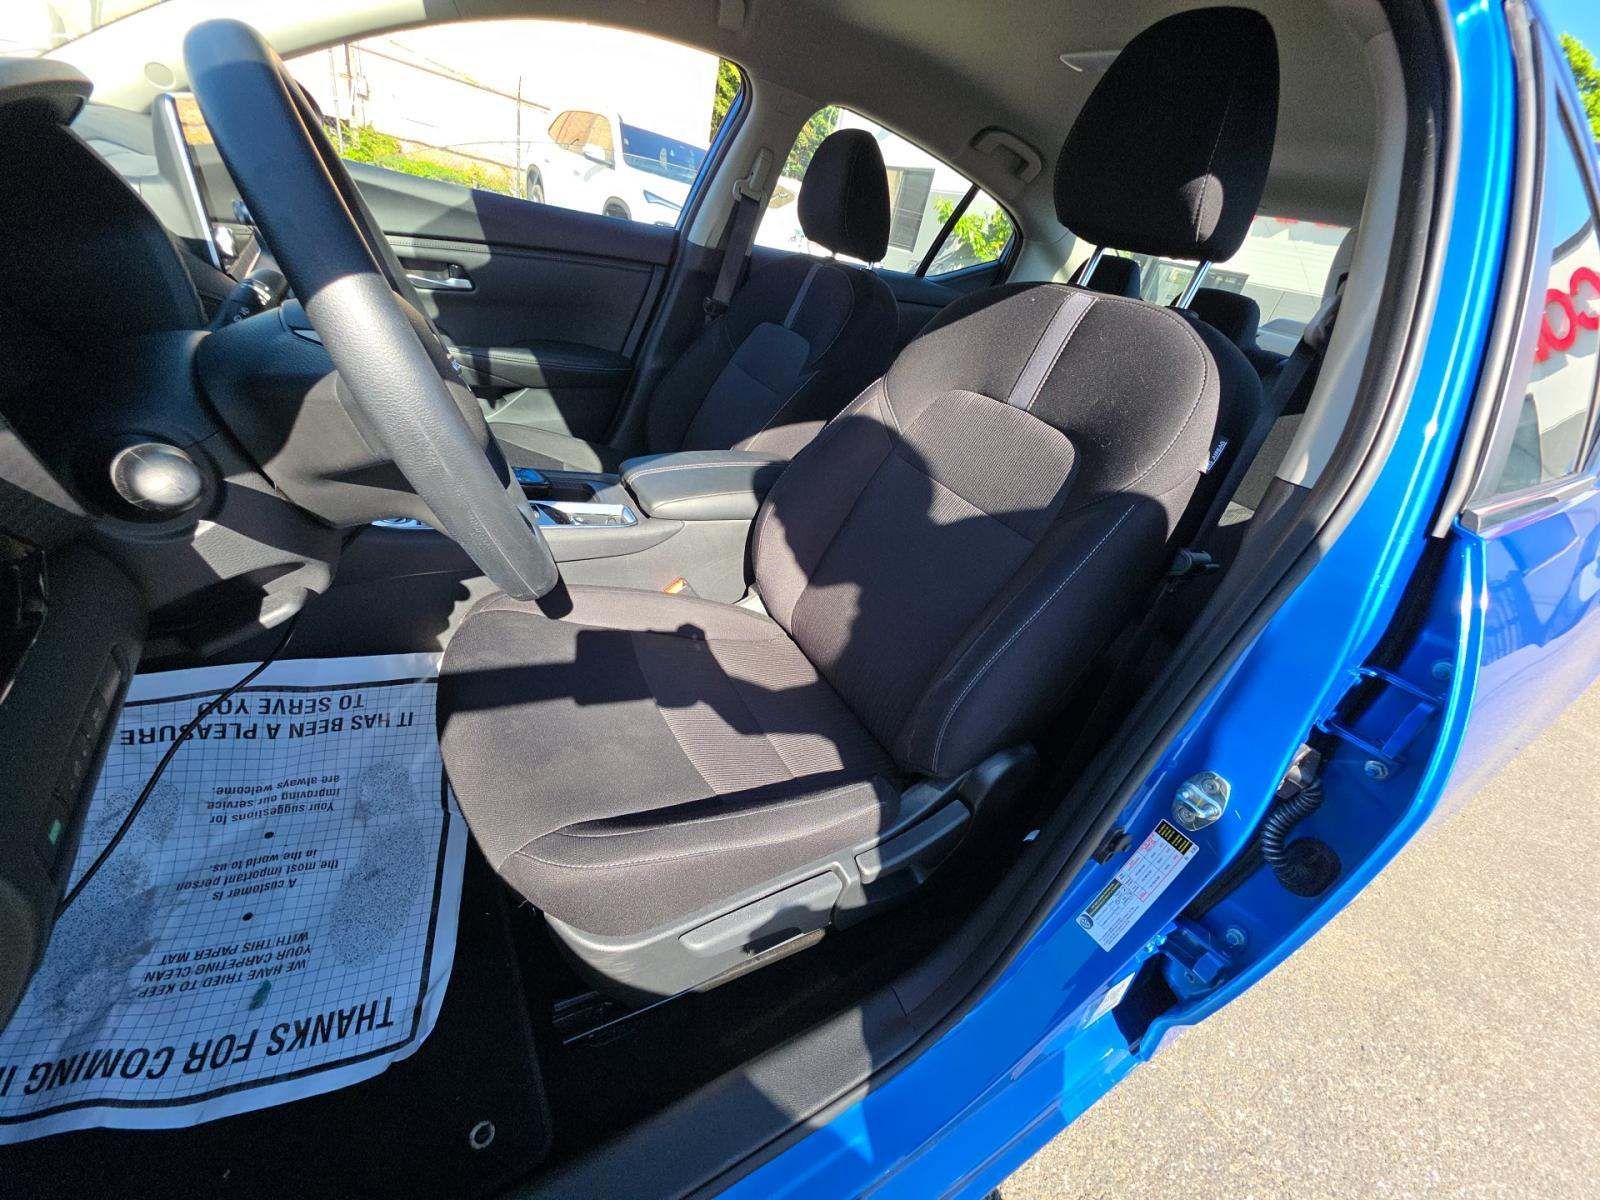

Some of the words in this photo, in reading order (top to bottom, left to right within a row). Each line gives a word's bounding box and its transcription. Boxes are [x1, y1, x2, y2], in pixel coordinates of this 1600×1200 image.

[258, 695, 333, 715] SERVE
[338, 693, 366, 711] TO
[289, 717, 345, 737] BEEN
[350, 711, 391, 731] HAS
[399, 711, 414, 728] IT
[119, 722, 258, 746] PLEASURE
[267, 722, 282, 740] A
[276, 774, 319, 790] always
[320, 775, 341, 784] are
[212, 783, 273, 796] welcome.
[280, 787, 340, 801] improving
[207, 798, 255, 810] service
[257, 793, 278, 805] our
[231, 800, 305, 822] suggestions
[308, 802, 335, 812] Your
[209, 814, 228, 826] for
[245, 853, 280, 866] world
[282, 850, 302, 861] the
[305, 849, 318, 858] in
[210, 863, 228, 873] us.
[230, 859, 242, 870] to
[286, 861, 316, 874] most
[320, 859, 340, 870] the
[223, 866, 282, 882] important
[175, 876, 222, 892] person
[227, 880, 284, 895] customer
[288, 878, 298, 889] A
[212, 891, 224, 901] is
[242, 938, 271, 952] THIS
[277, 931, 309, 946] WITH
[159, 951, 189, 966] MAT
[193, 943, 237, 961] PAPER
[276, 944, 311, 961] YOUR
[194, 955, 272, 976] CARPETING
[248, 964, 283, 981] HAVE
[287, 960, 306, 972] WE
[143, 966, 191, 983] CLEAN
[203, 973, 244, 988] TRIED
[137, 983, 175, 998] KEEP
[180, 979, 198, 992] TO
[265, 996, 394, 1057] THANKS
[182, 1029, 259, 1076] FOR
[24, 1045, 176, 1096] COMING
